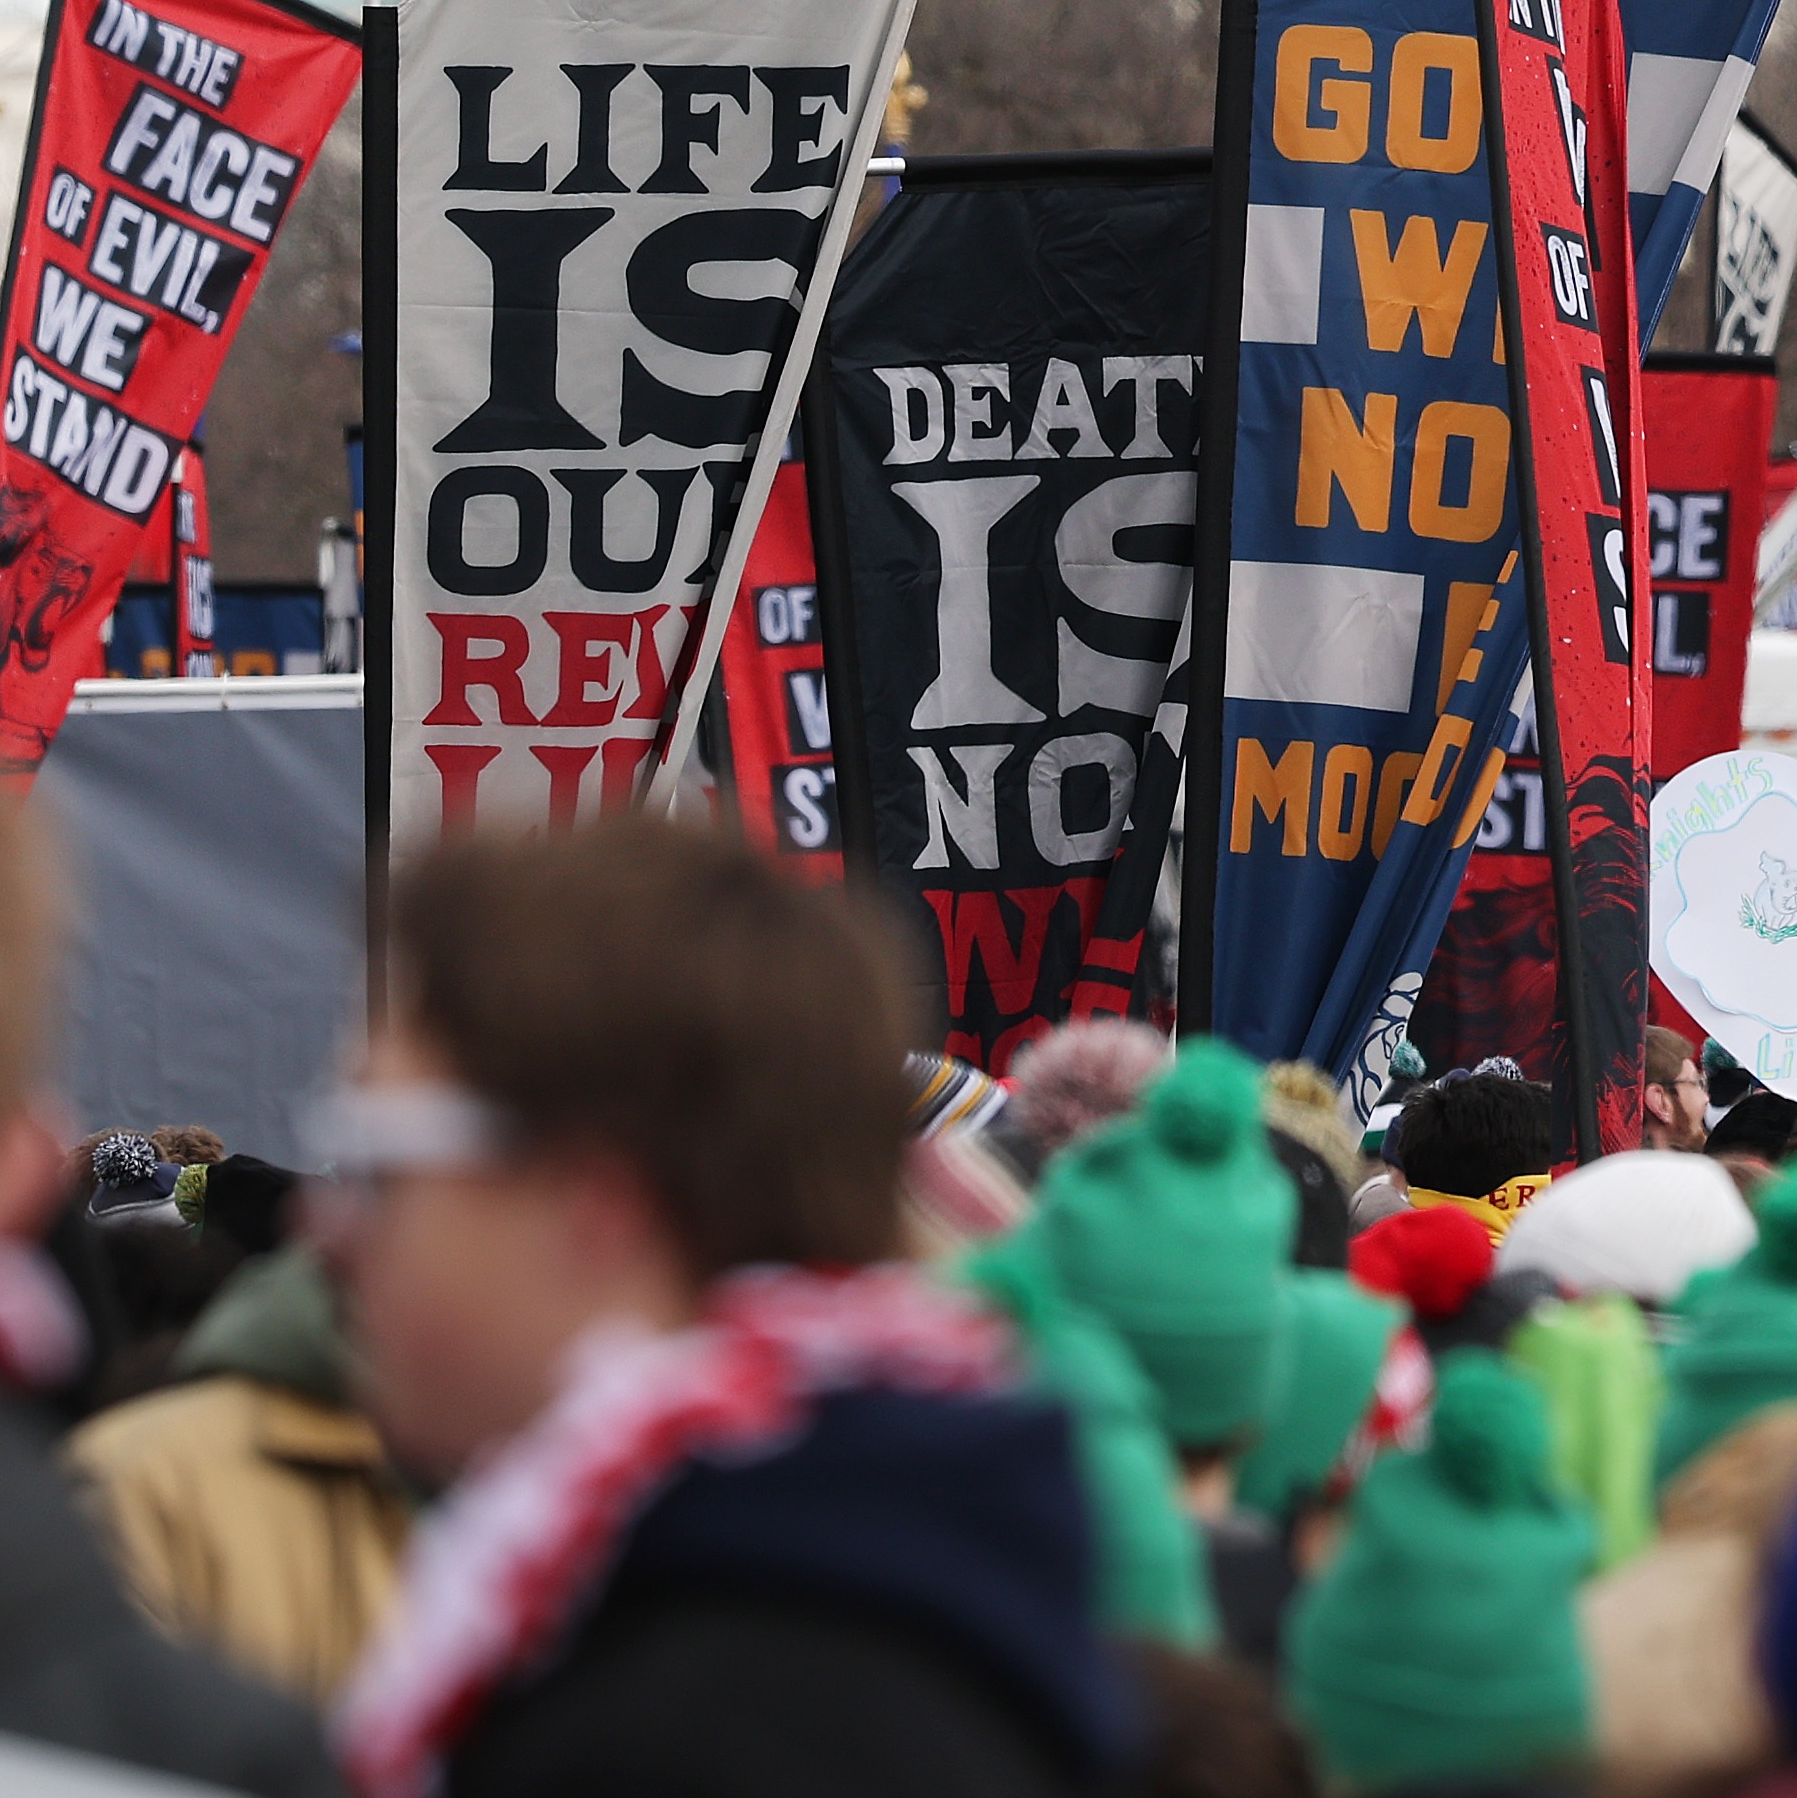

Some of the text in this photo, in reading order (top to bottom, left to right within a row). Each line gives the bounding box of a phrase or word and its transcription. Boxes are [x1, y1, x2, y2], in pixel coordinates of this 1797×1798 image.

[157, 23, 239, 106] THE
[442, 63, 851, 194] LIFE
[1272, 24, 1483, 175] GO
[110, 92, 297, 242] FACE
[46, 172, 221, 334] OF EVIL,
[1547, 234, 1589, 321] OF
[36, 265, 145, 391] WE
[432, 205, 831, 453] IS
[3, 354, 170, 515] STAND
[872, 354, 1203, 466] DEAT
[890, 470, 1198, 730] IS
[1649, 492, 1724, 580] CE
[905, 731, 1147, 870] NO
